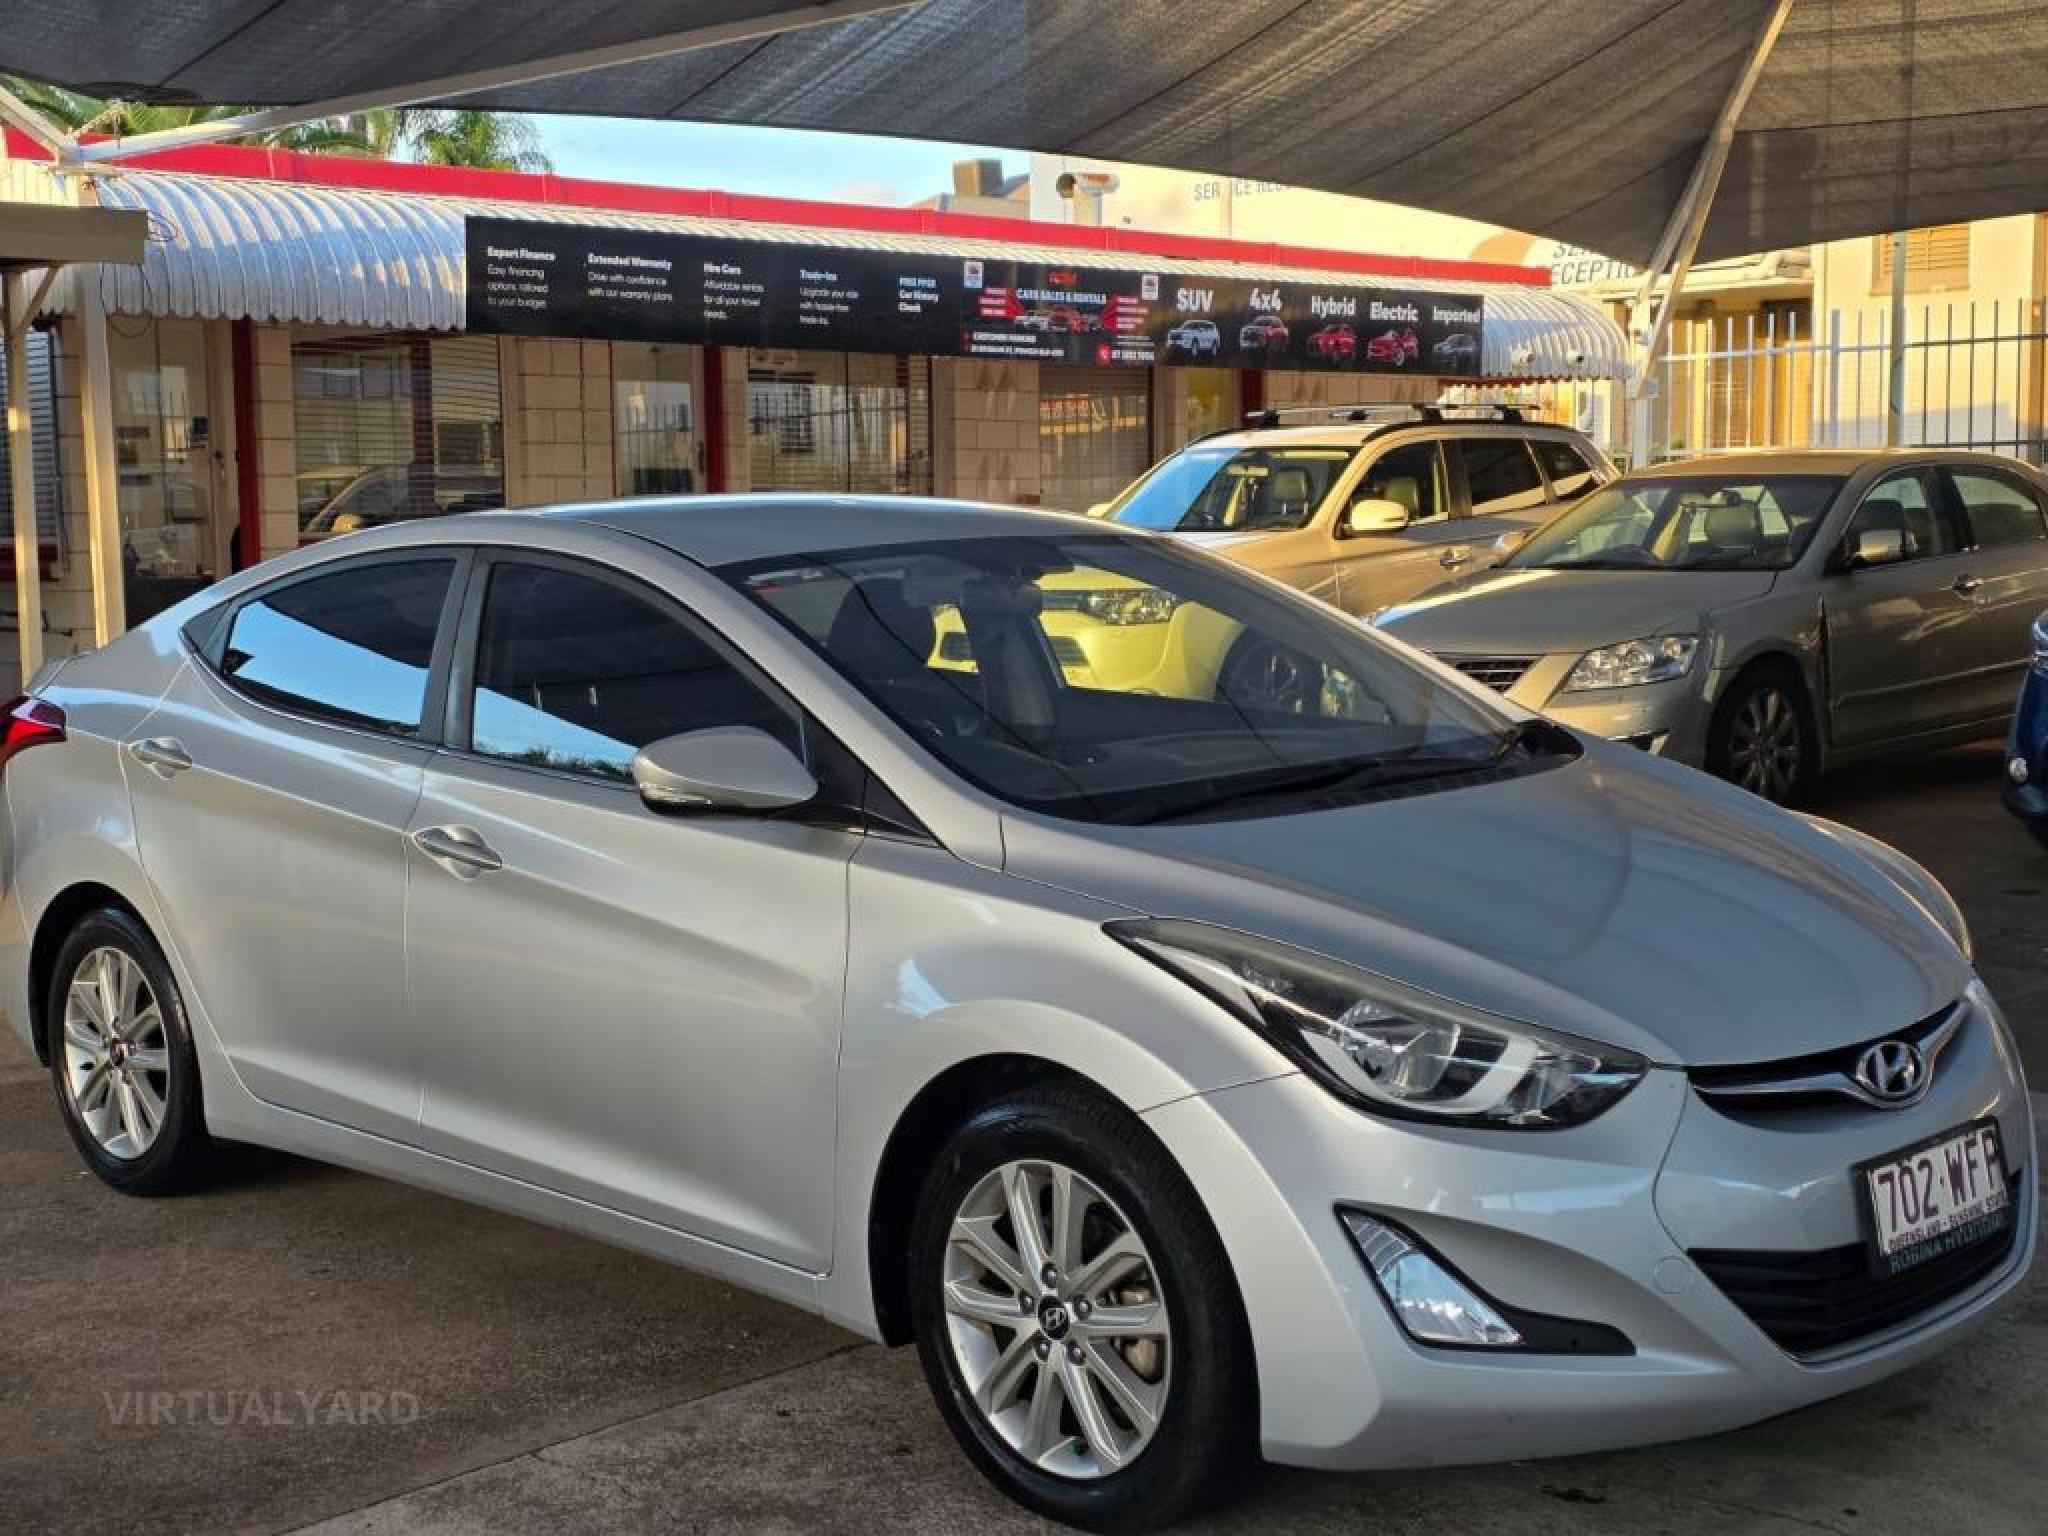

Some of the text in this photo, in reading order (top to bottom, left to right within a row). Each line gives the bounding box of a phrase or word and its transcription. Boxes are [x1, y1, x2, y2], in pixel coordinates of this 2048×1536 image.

[487, 246, 556, 261] Expert Finance
[588, 252, 672, 271] Extended Warranty
[704, 262, 742, 275] Hire Cars
[508, 266, 545, 280] financing
[588, 272, 667, 286] Drive with confidence
[704, 280, 740, 291] Affordable
[588, 288, 604, 297] with
[620, 291, 650, 301] warranty
[832, 291, 845, 299] your
[900, 289, 938, 303] Car History
[1176, 288, 1214, 313] SUV
[1250, 287, 1282, 311] 4x4
[899, 302, 921, 313] Check
[1311, 295, 1356, 318] Hybrid
[1370, 301, 1419, 321] Electric
[1433, 305, 1480, 325] Imported
